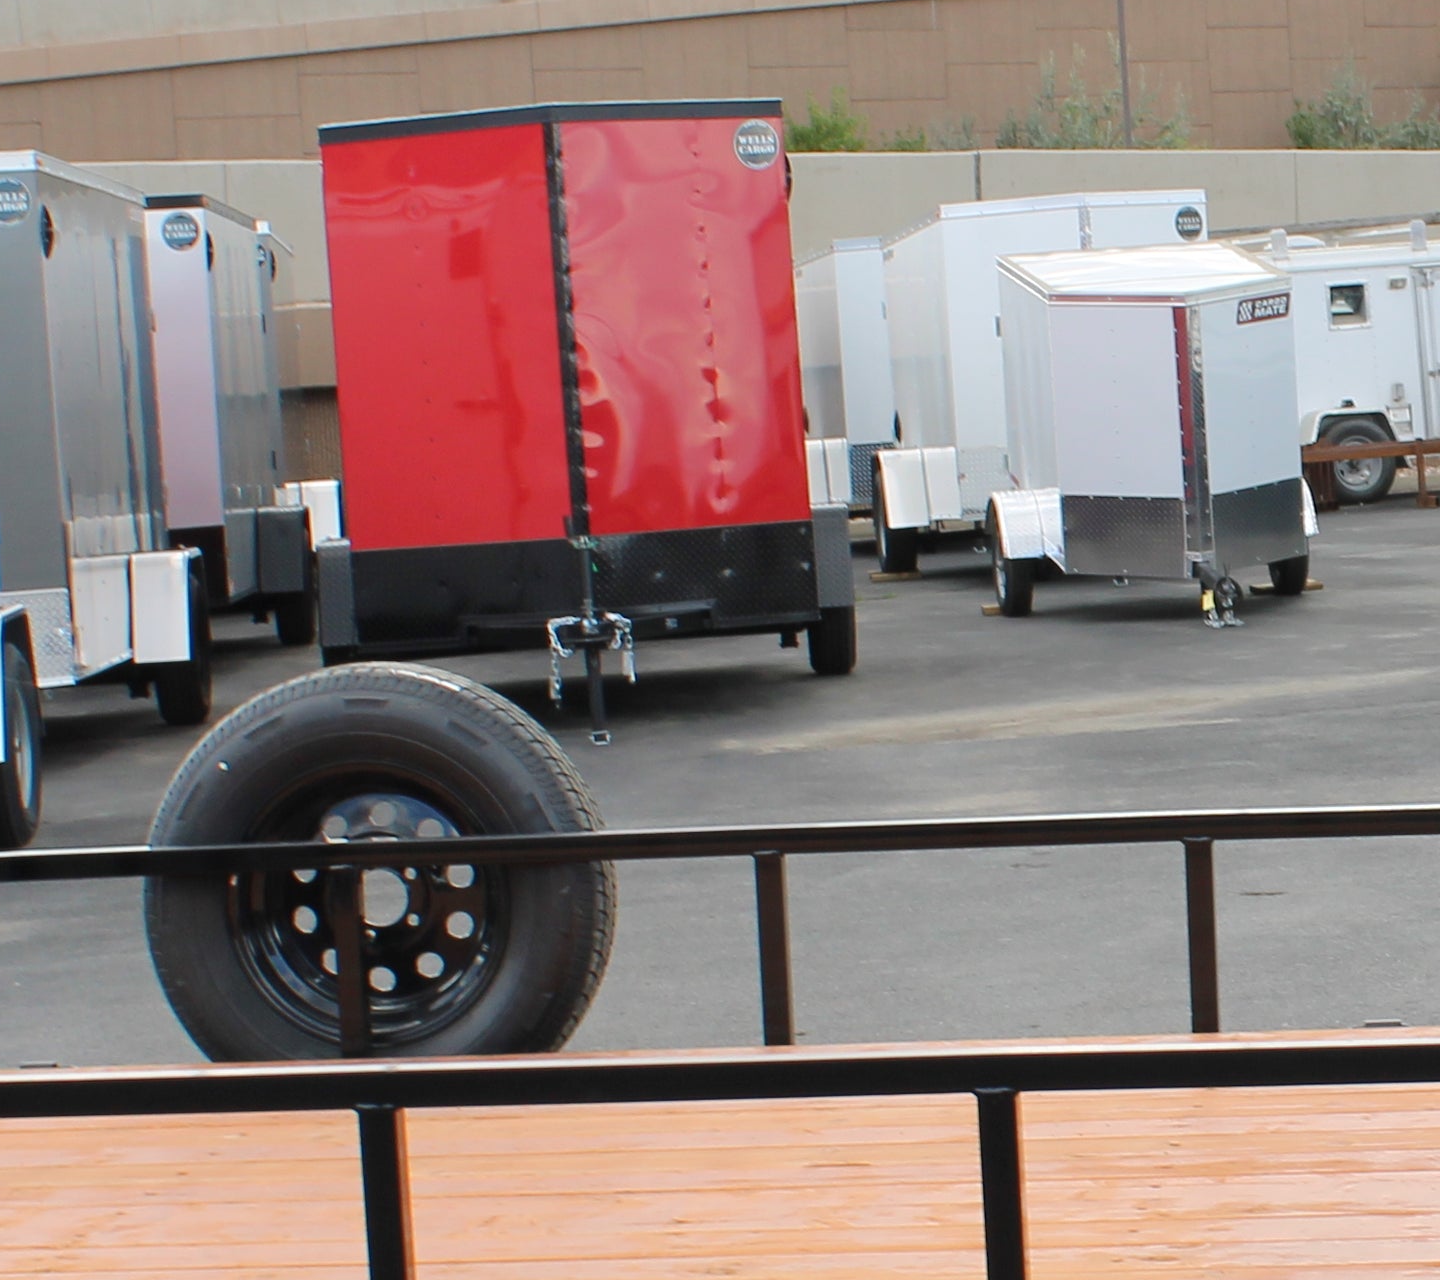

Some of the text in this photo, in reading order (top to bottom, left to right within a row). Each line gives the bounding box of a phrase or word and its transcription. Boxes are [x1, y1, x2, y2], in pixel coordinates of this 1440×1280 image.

[738, 135, 775, 145] WELLS
[738, 145, 775, 154] CARGO
[1254, 296, 1287, 308] CARGO
[1254, 305, 1287, 318] MATE
